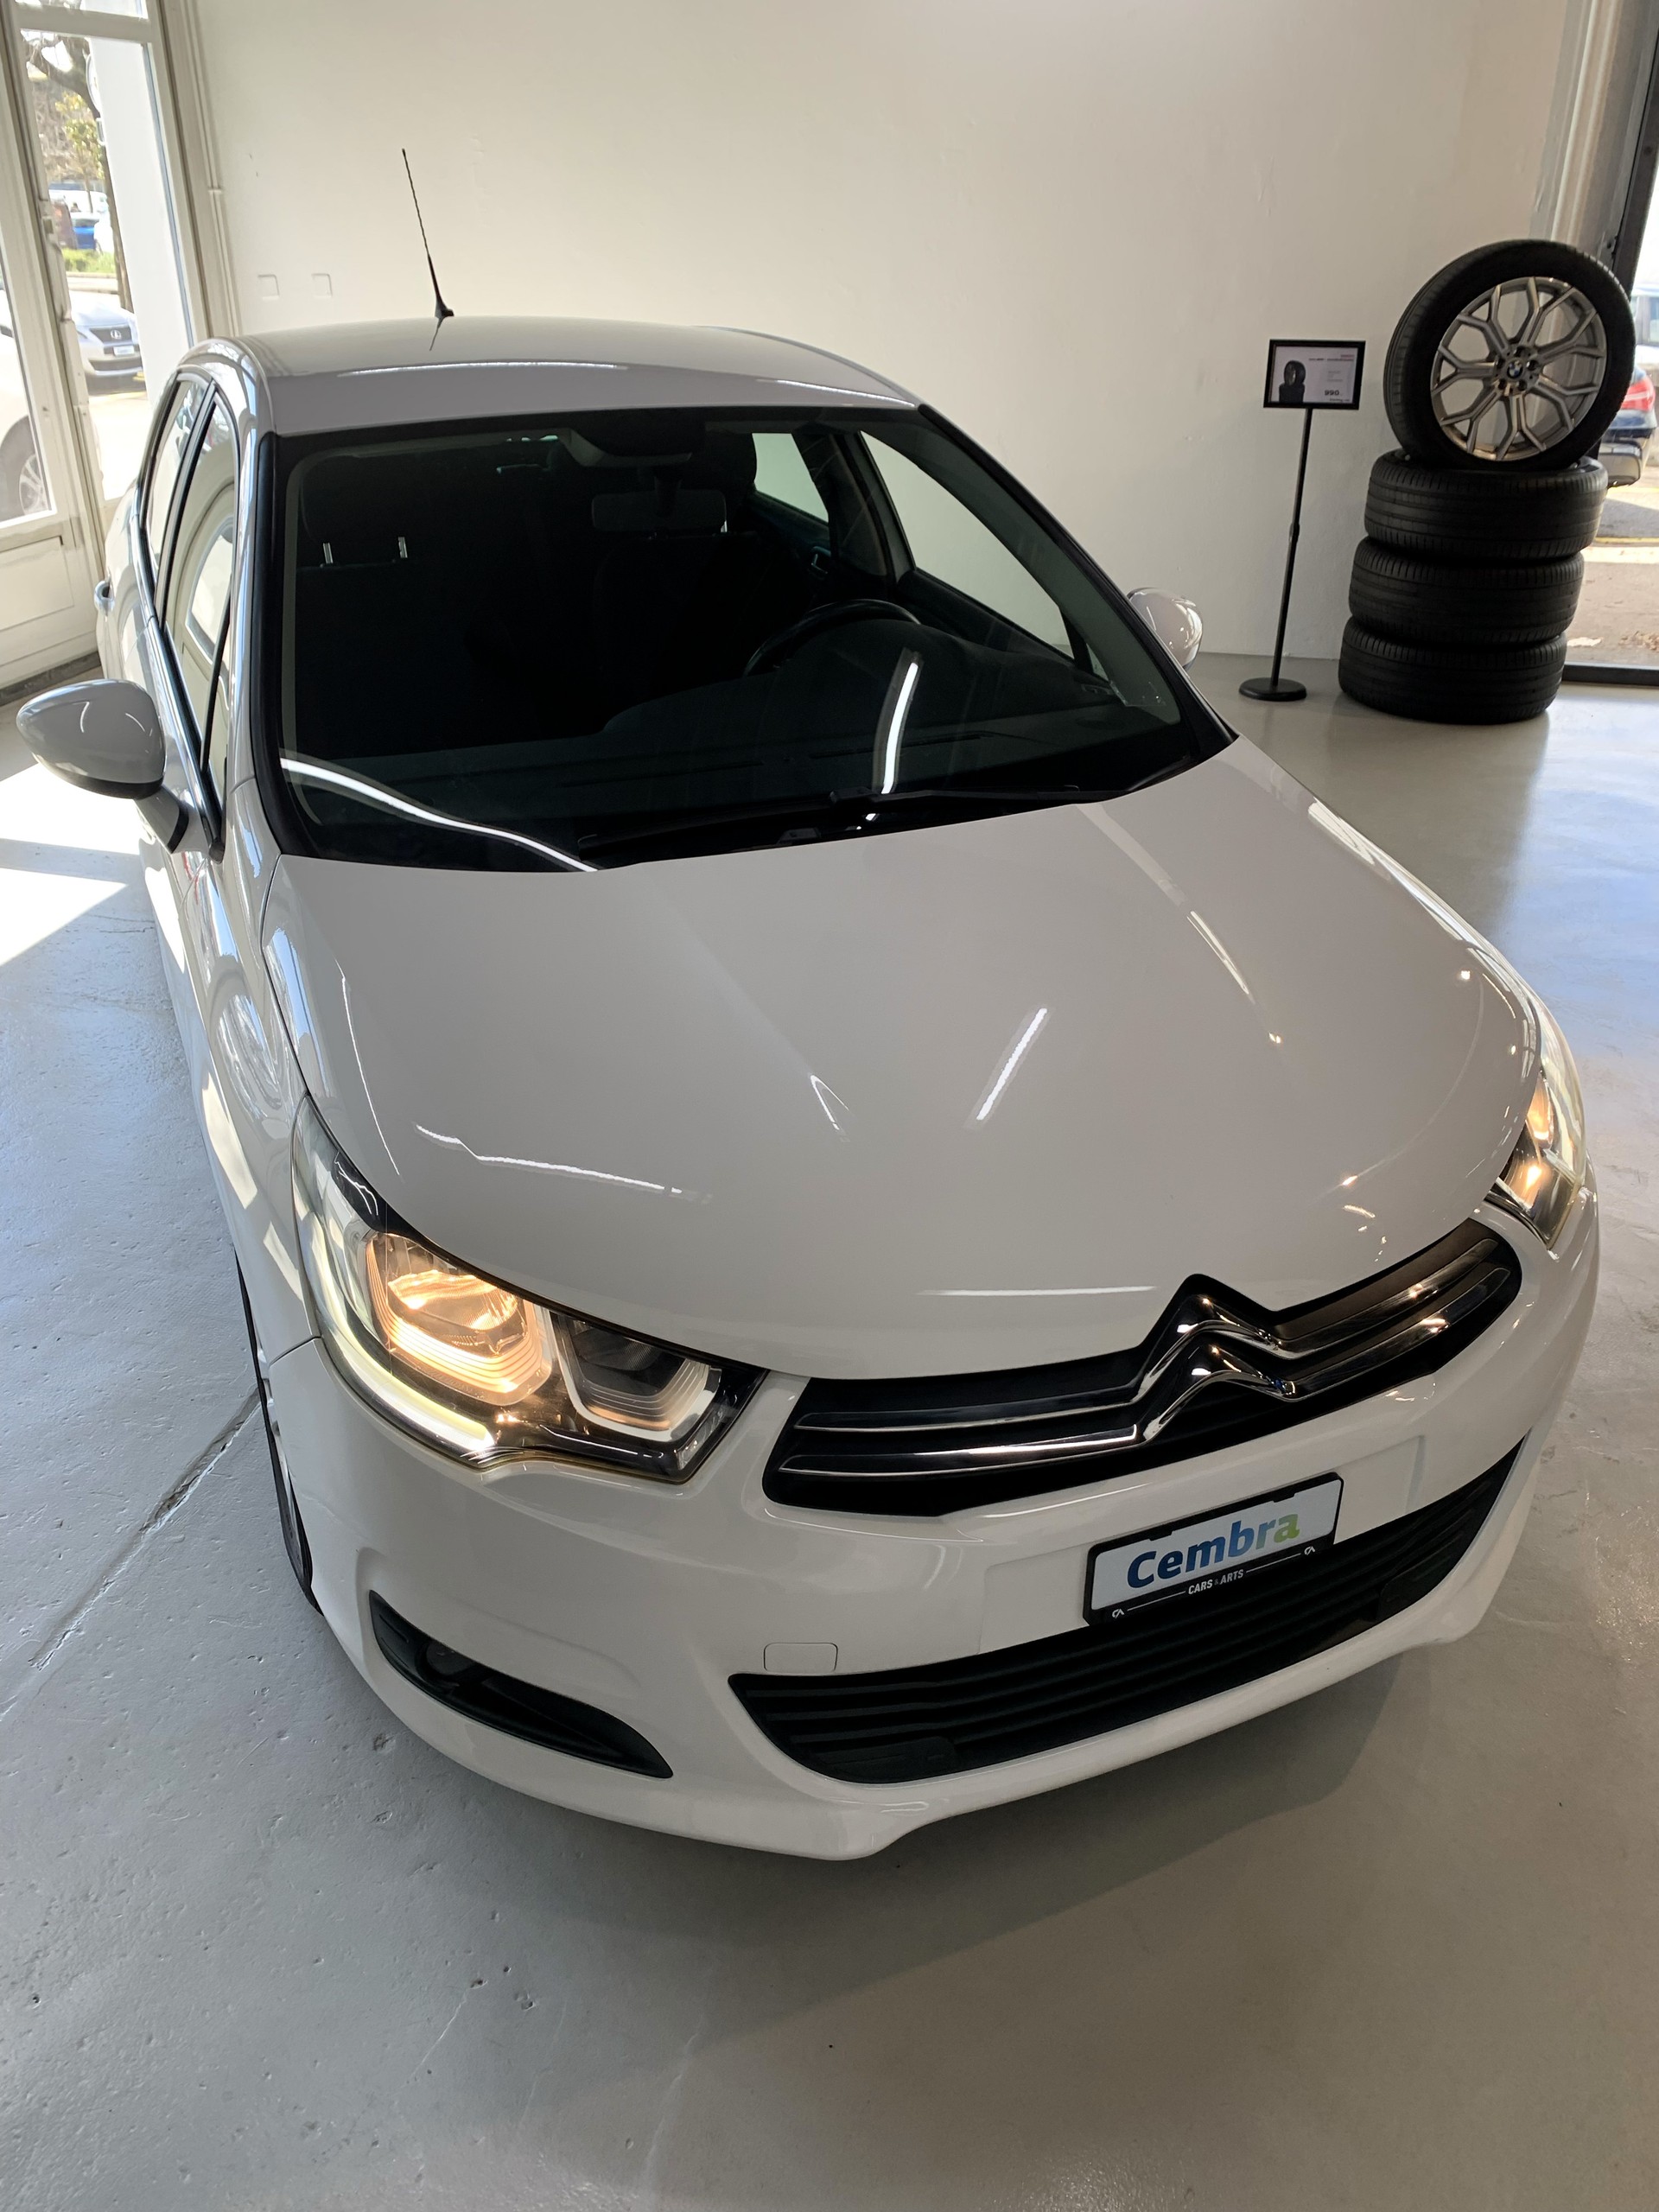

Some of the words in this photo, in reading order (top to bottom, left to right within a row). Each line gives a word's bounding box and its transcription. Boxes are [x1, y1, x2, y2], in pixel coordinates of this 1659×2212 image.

[1127, 1513, 1300, 1589] Cembra
[1188, 1580, 1213, 1594] CARS
[1219, 1569, 1244, 1586] ARTS
